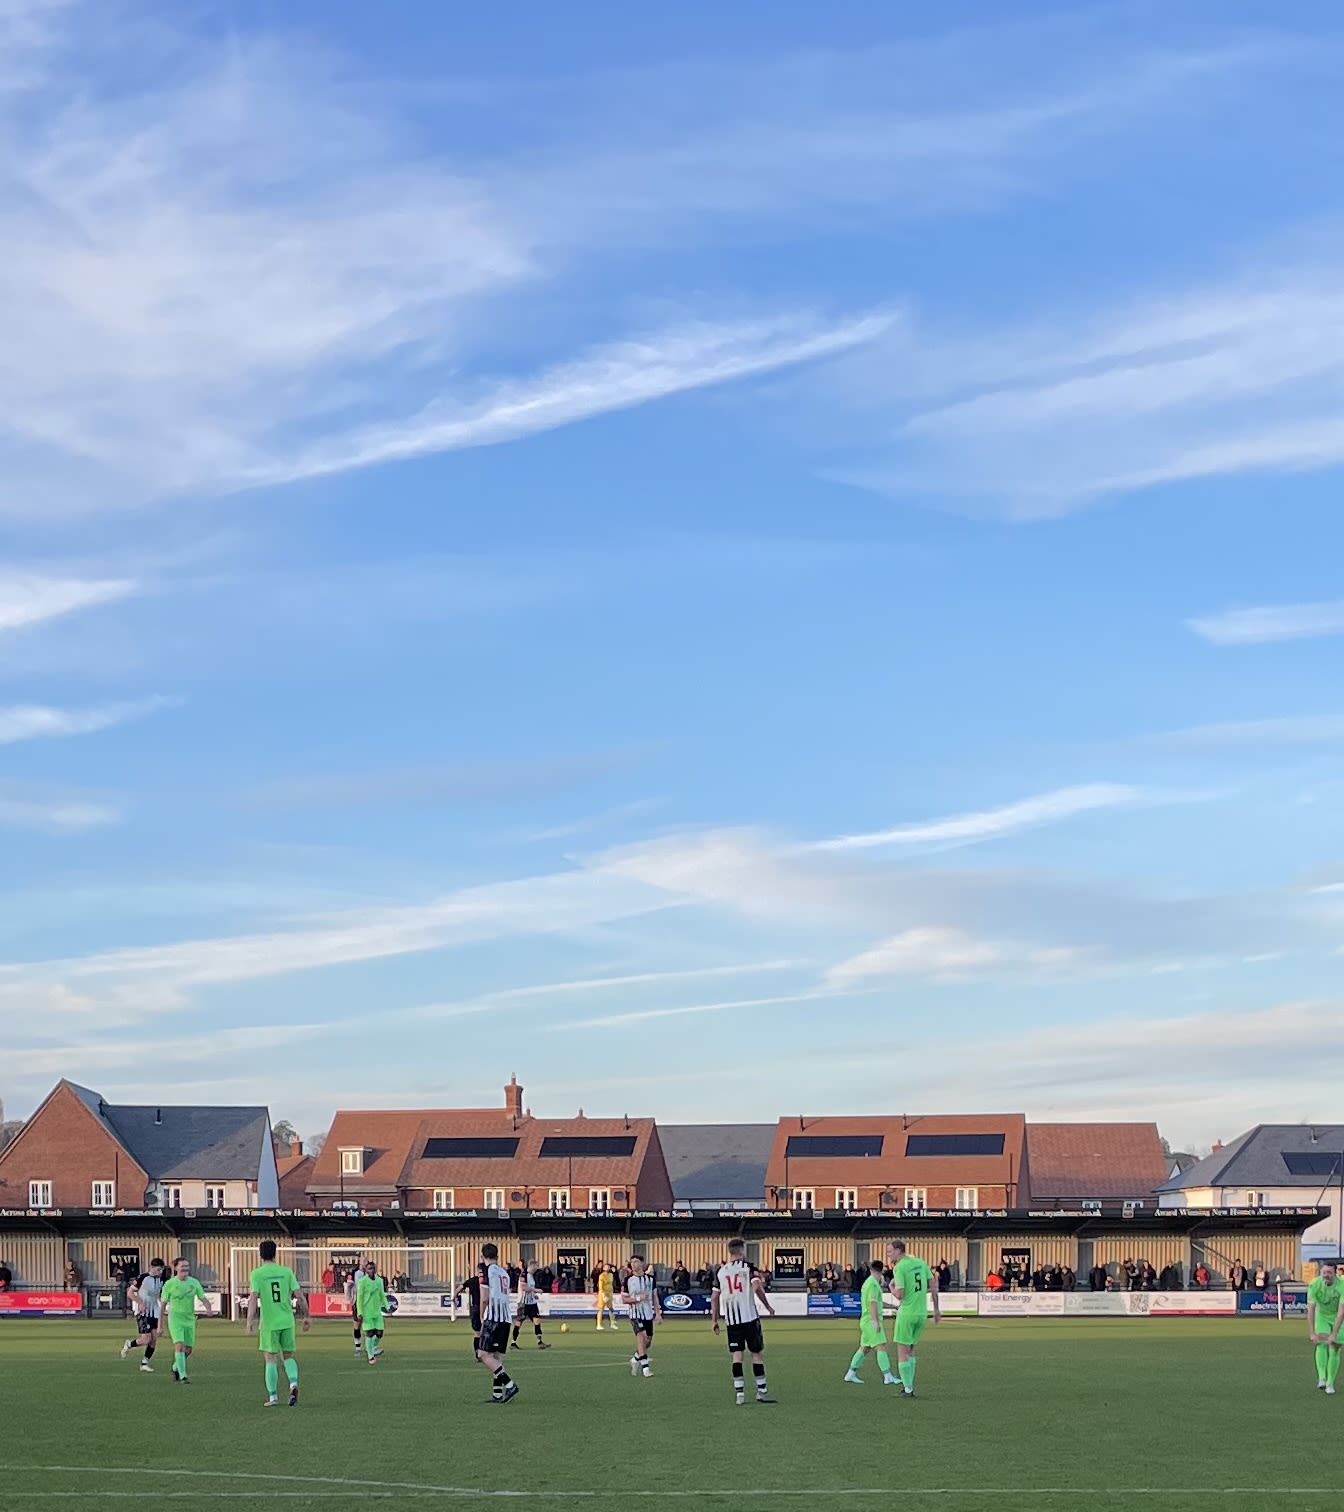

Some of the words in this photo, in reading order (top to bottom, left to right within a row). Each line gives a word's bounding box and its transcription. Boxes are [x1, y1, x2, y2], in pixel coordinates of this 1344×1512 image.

[0, 1207, 24, 1216] Across
[26, 1207, 38, 1216] the
[40, 1207, 62, 1216] South
[558, 1255, 586, 1264] WYATT
[776, 1255, 802, 1265] WYATT
[1003, 1255, 1029, 1263] WYATT
[725, 1273, 743, 1295] 14
[915, 1272, 922, 1292] 5
[271, 1282, 281, 1303] 6
[1002, 1294, 1032, 1303] Energy
